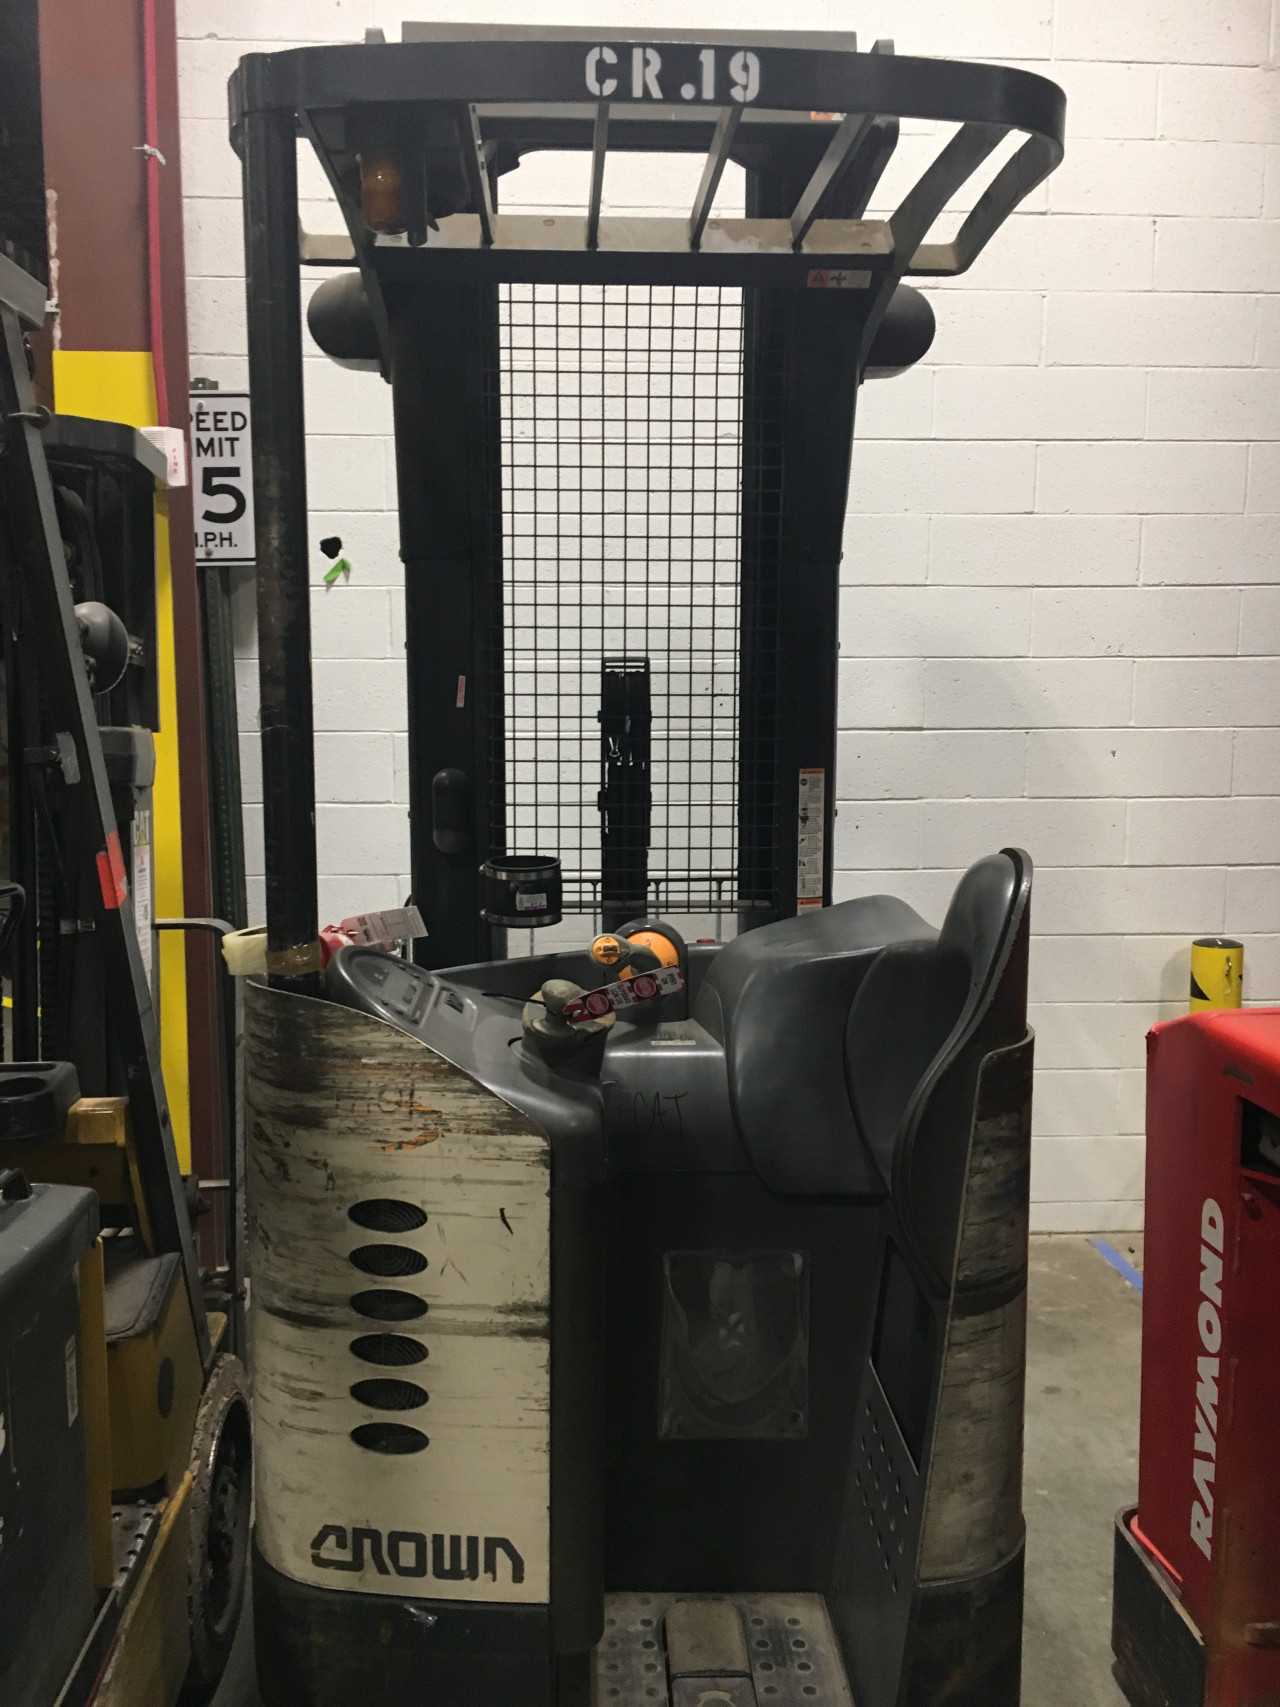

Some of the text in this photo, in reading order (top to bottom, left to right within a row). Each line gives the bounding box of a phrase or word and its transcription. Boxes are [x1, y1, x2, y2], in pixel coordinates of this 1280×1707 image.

[190, 411, 248, 432] EED
[195, 437, 240, 458] MIT
[201, 466, 247, 524] 5
[194, 531, 238, 548] .P.H.
[1190, 1197, 1225, 1561] RAYMOND
[310, 1524, 525, 1584] CROWN
